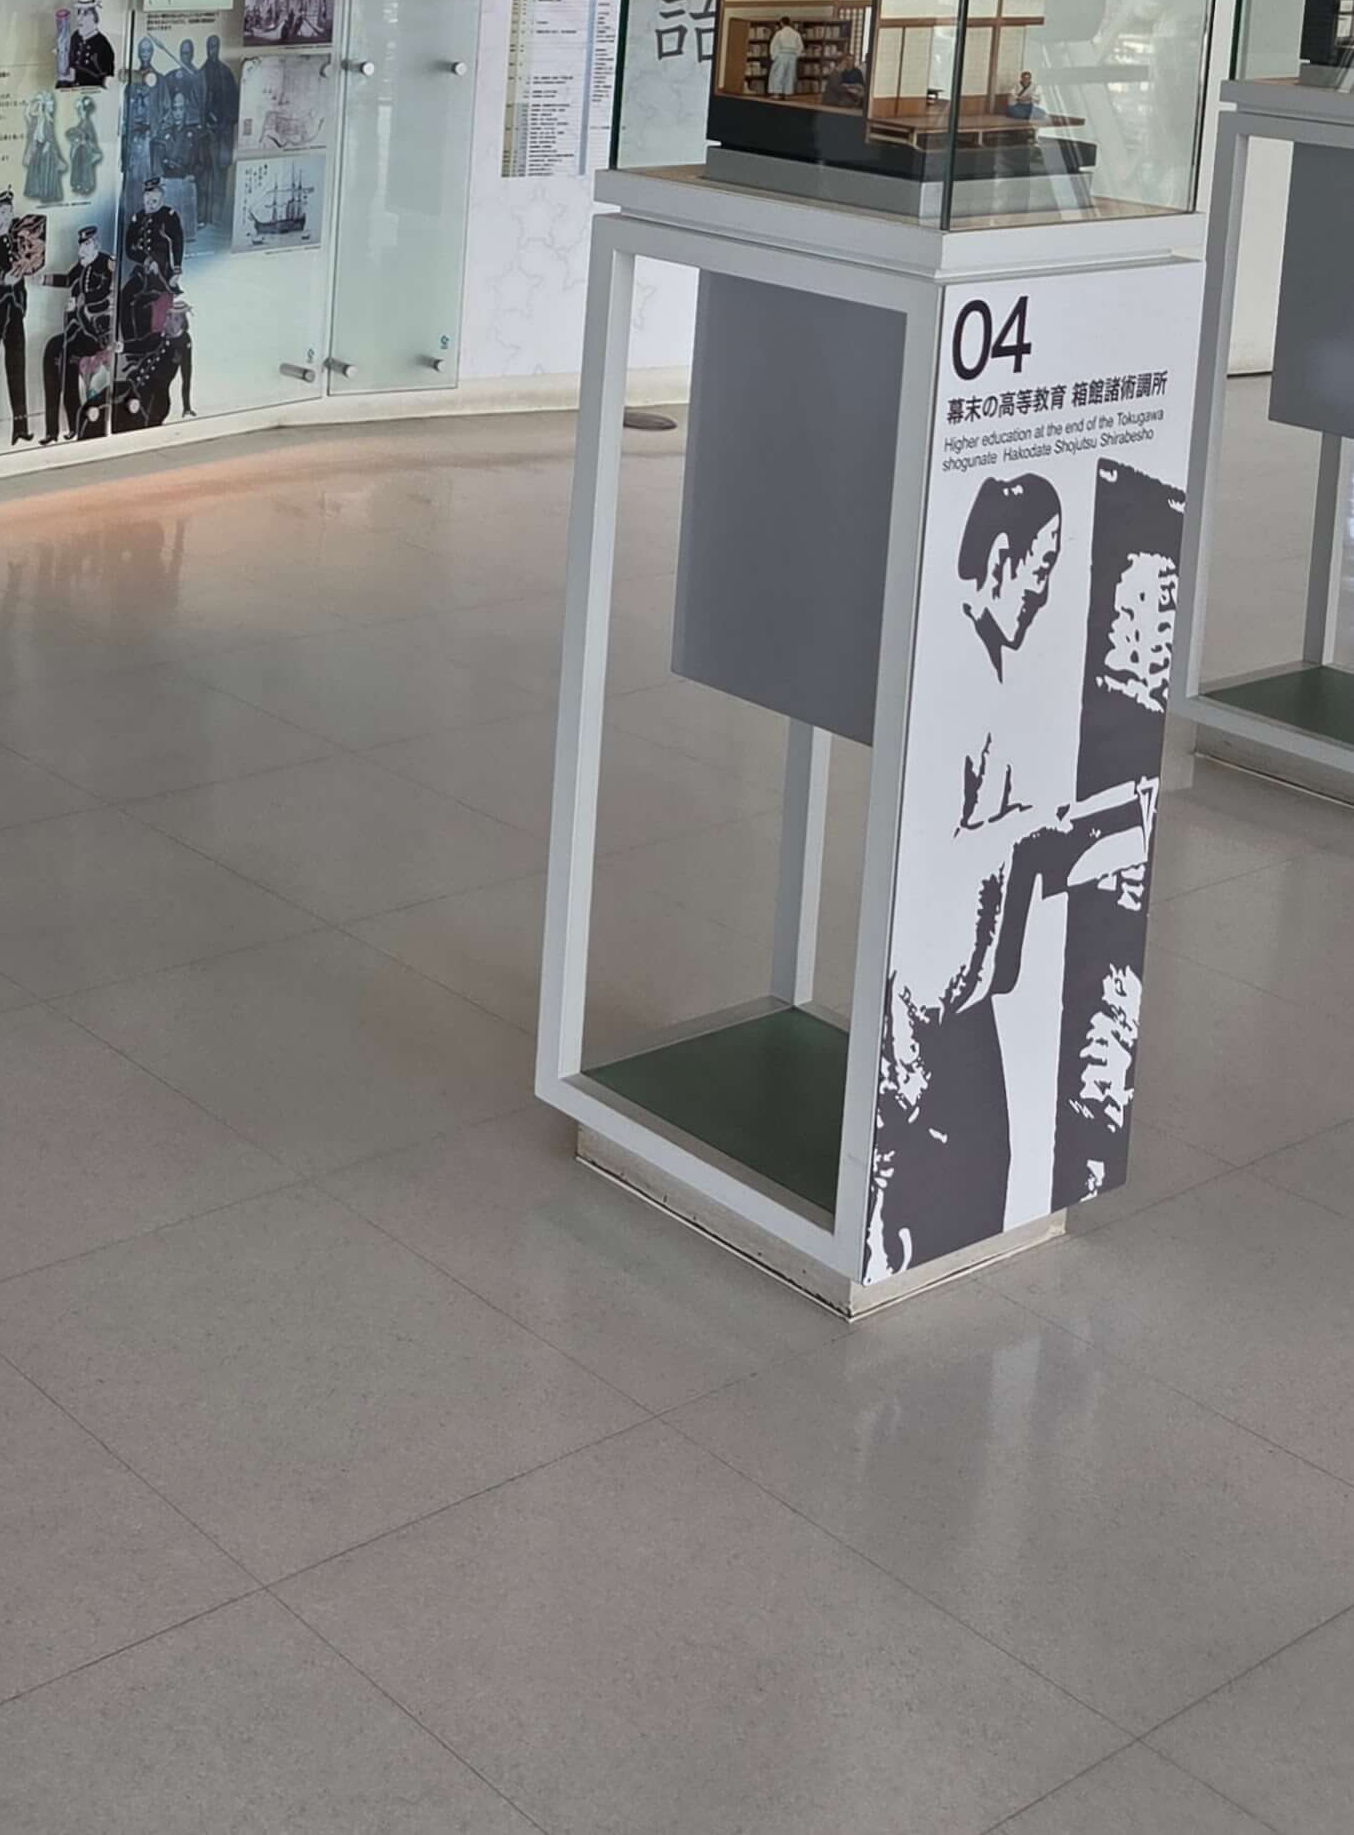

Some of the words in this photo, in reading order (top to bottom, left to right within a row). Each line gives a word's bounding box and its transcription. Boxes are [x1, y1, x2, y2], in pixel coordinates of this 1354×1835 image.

[952, 295, 1031, 381] 04
[946, 385, 1066, 425] 幕末の高等教育
[1072, 370, 1169, 408] 箱館諸術調所
[942, 451, 997, 473] shogunate
[1003, 441, 1052, 462] Hakodate
[1054, 435, 1097, 456] Shojutsu
[1100, 428, 1154, 448] Shirabesho
[944, 434, 979, 455] Higher
[982, 426, 1032, 448] education
[1034, 425, 1044, 440] at
[1046, 422, 1062, 437] the
[1066, 419, 1084, 434] end
[1087, 416, 1098, 431] of
[1099, 414, 1114, 429] the
[1118, 409, 1164, 430] Tokugawa
